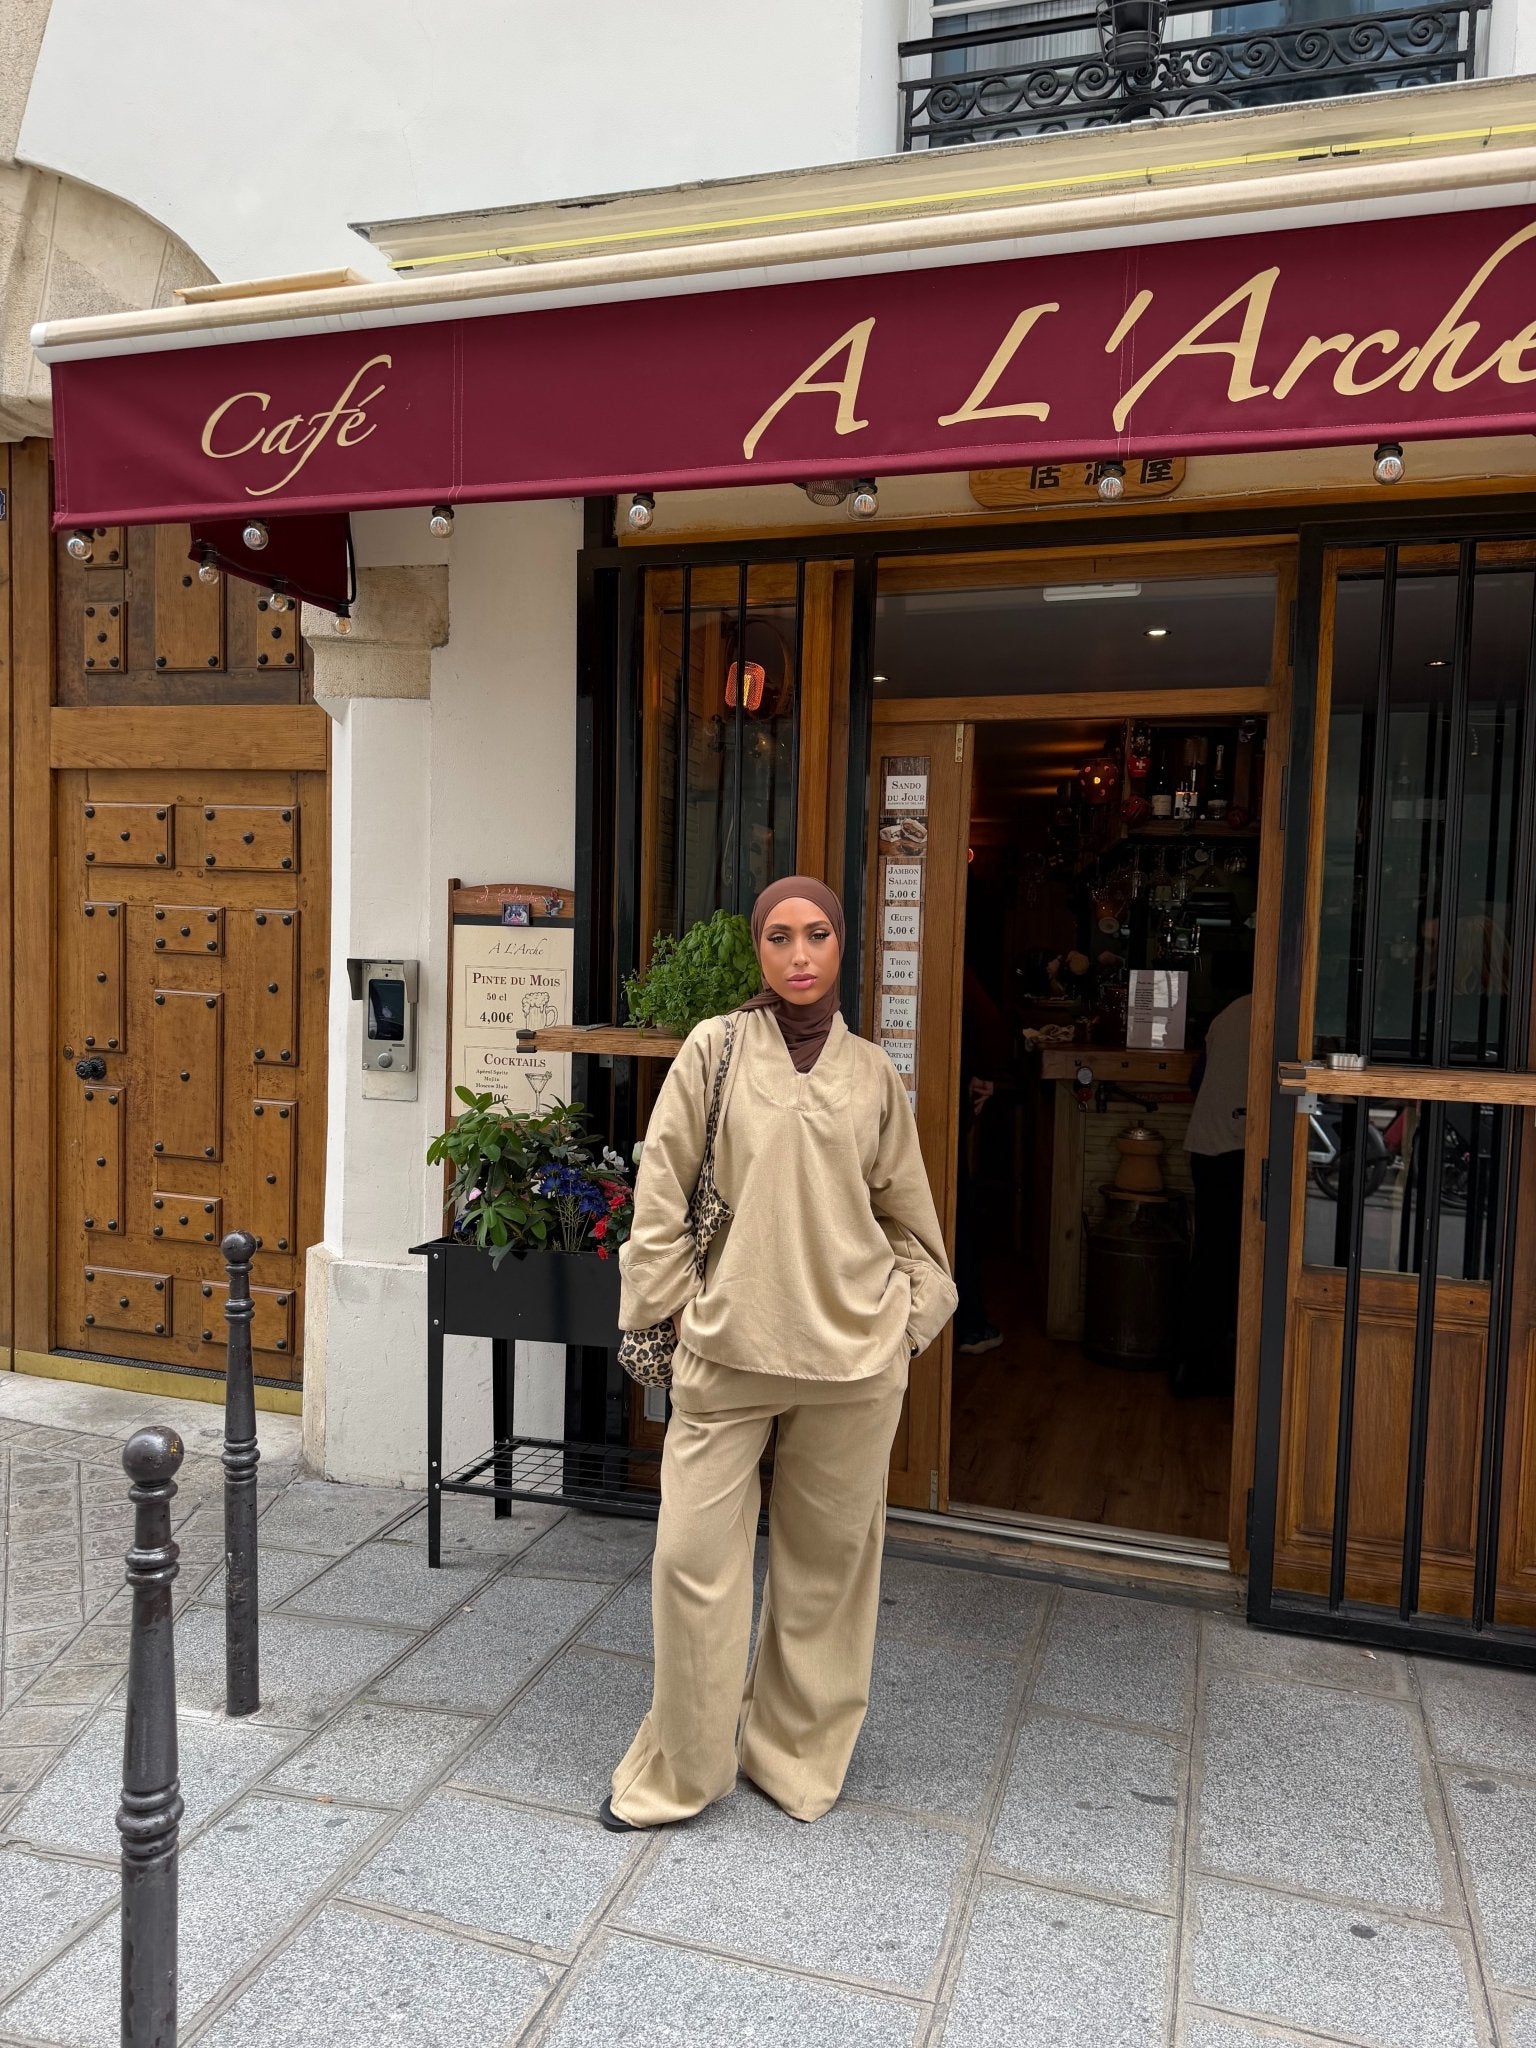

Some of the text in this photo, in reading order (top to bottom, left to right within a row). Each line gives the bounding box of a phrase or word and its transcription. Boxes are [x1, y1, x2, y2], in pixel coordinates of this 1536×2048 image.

[743, 316, 876, 459] A
[201, 354, 392, 496] Café
[892, 780, 922, 790] SANDO
[901, 792, 926, 802] JOUR
[888, 866, 919, 875] JAMBON
[888, 877, 918, 886] SALADE
[889, 957, 911, 966] THON
[473, 972, 507, 985] PINTE
[530, 974, 561, 987] MOIS
[486, 992, 497, 1001] 50
[889, 996, 910, 1005] PORC
[479, 1011, 514, 1025] 4,00€
[883, 1039, 913, 1049] POULET
[484, 1052, 546, 1067] COCKTAILS
